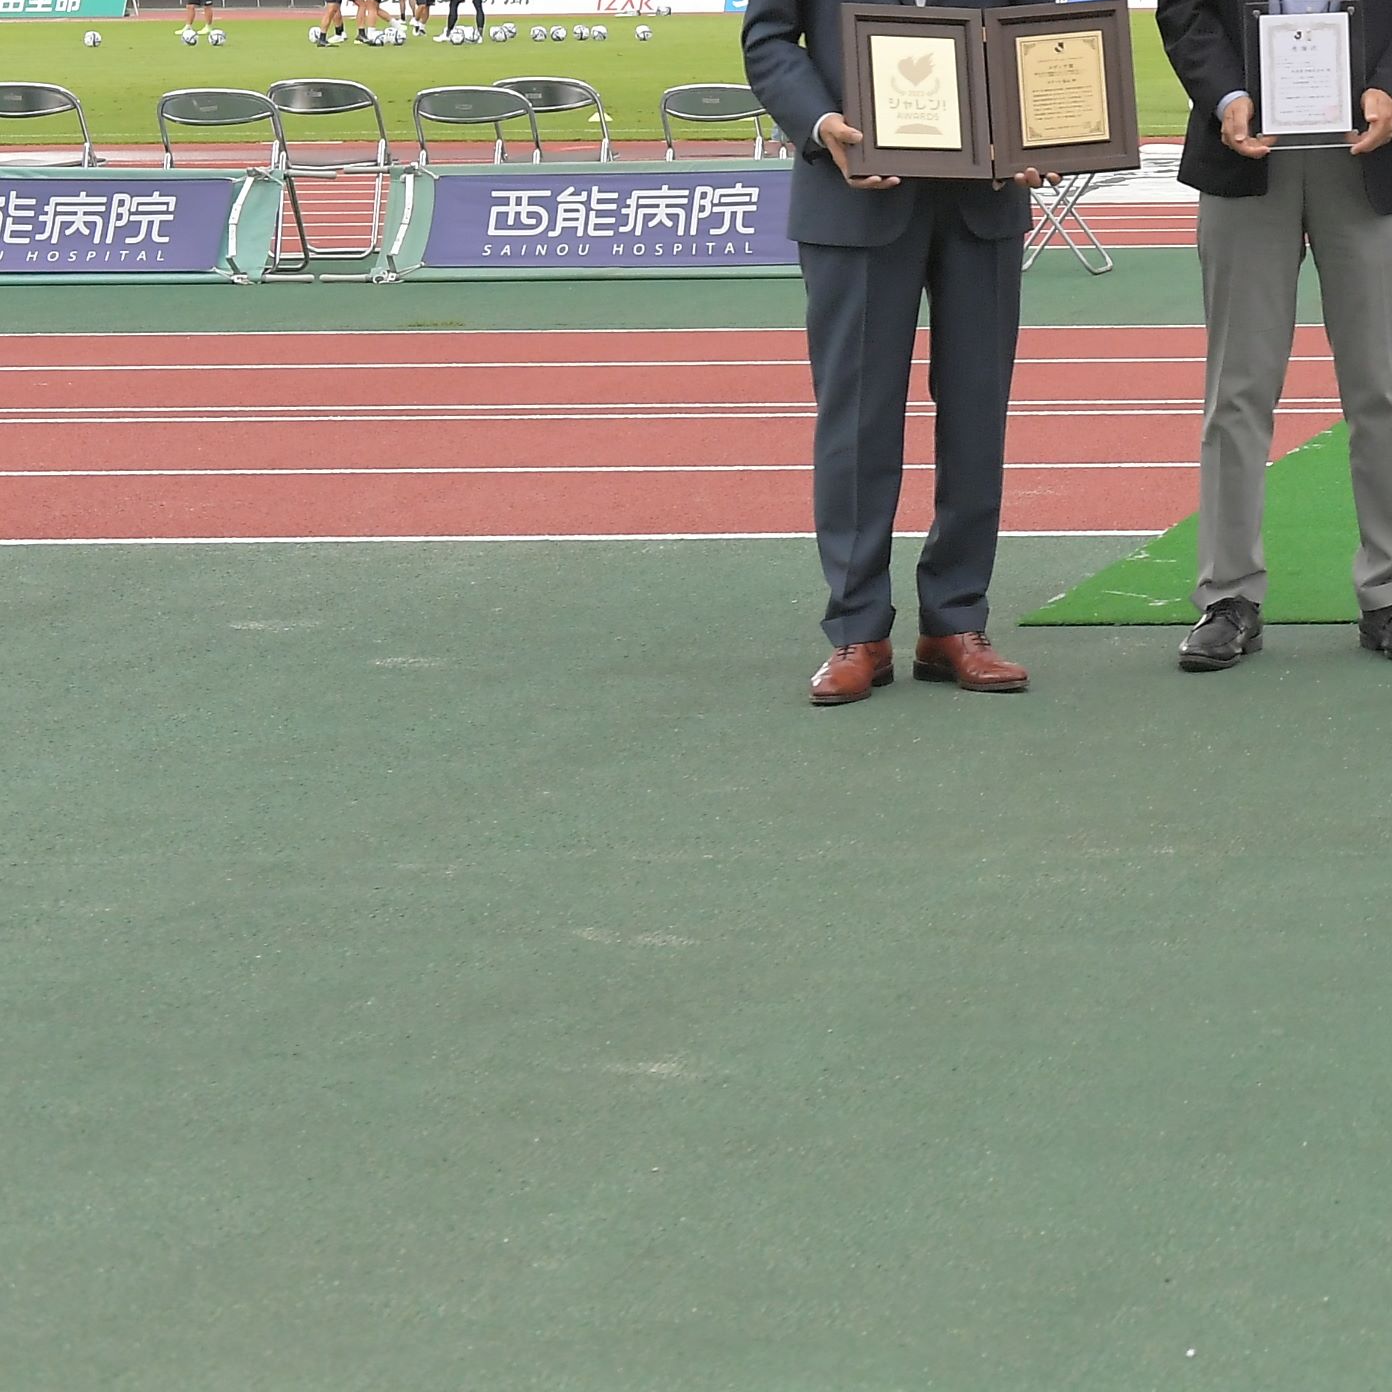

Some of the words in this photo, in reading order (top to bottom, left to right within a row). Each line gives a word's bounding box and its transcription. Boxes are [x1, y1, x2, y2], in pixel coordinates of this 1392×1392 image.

[888, 97, 947, 111] シャレン!
[896, 112, 940, 121] AWARDS
[487, 183, 760, 237] 西能病院
[482, 243, 590, 256] SAINOU
[612, 241, 753, 256] HOSPITAL
[25, 251, 166, 262] HOSPITAL
